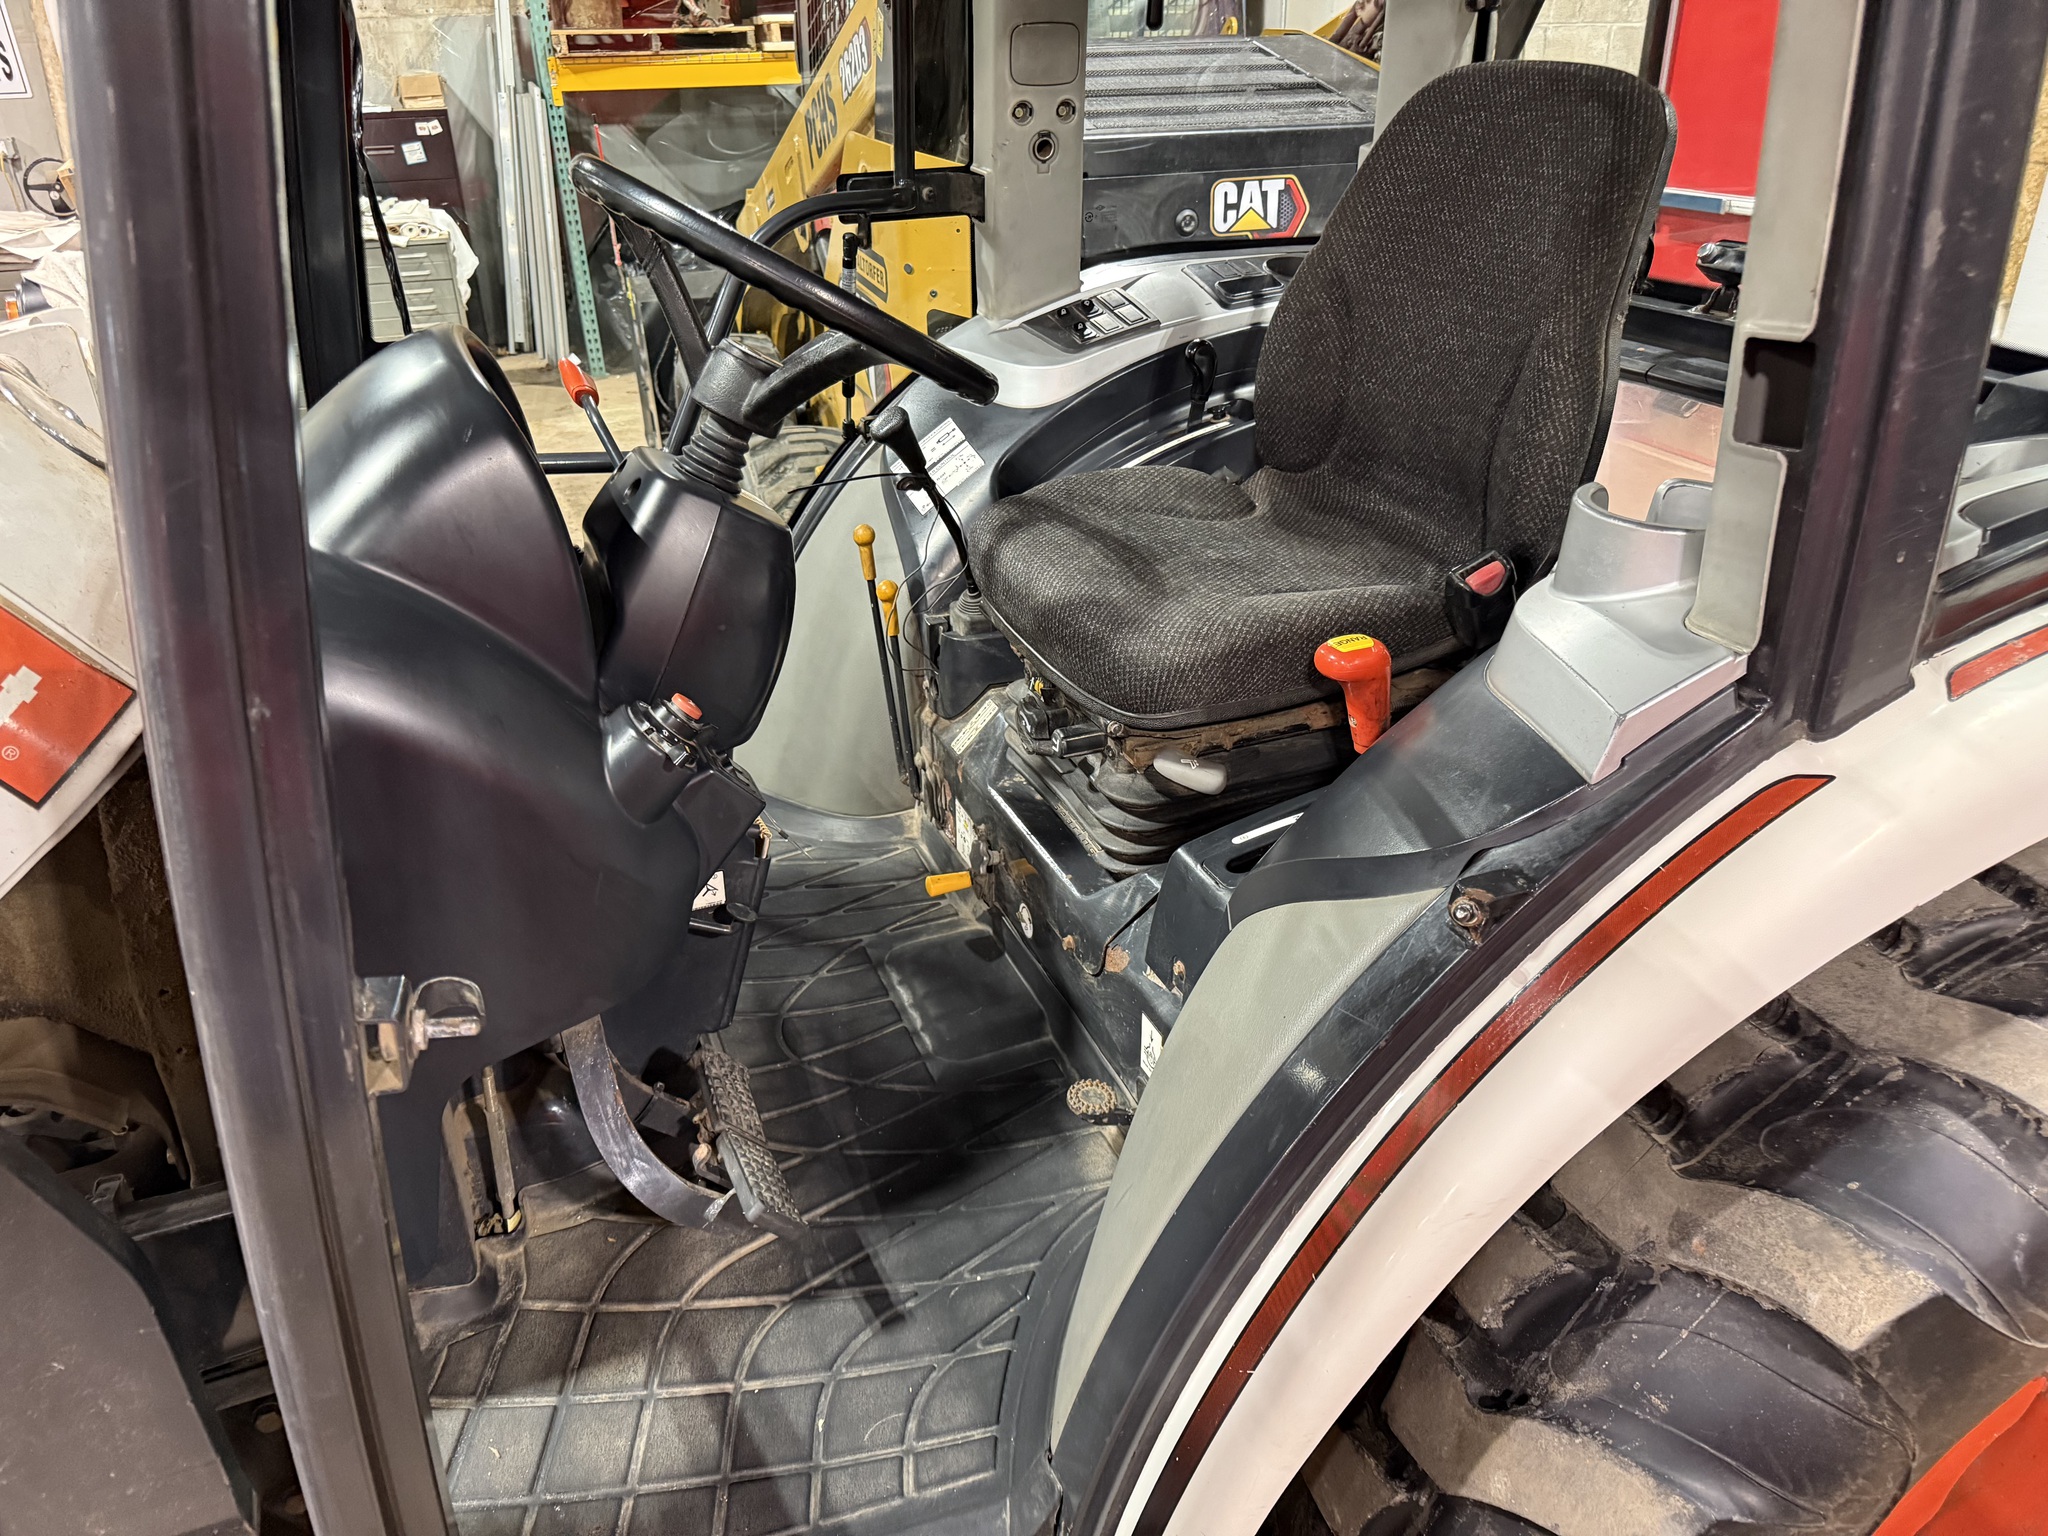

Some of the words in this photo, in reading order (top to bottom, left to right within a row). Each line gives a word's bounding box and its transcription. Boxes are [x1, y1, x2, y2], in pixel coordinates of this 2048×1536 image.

[840, 25, 868, 101] 262D3
[805, 74, 837, 169] PCHS
[1214, 179, 1285, 232] CAT
[1333, 635, 1368, 647] RANGE
